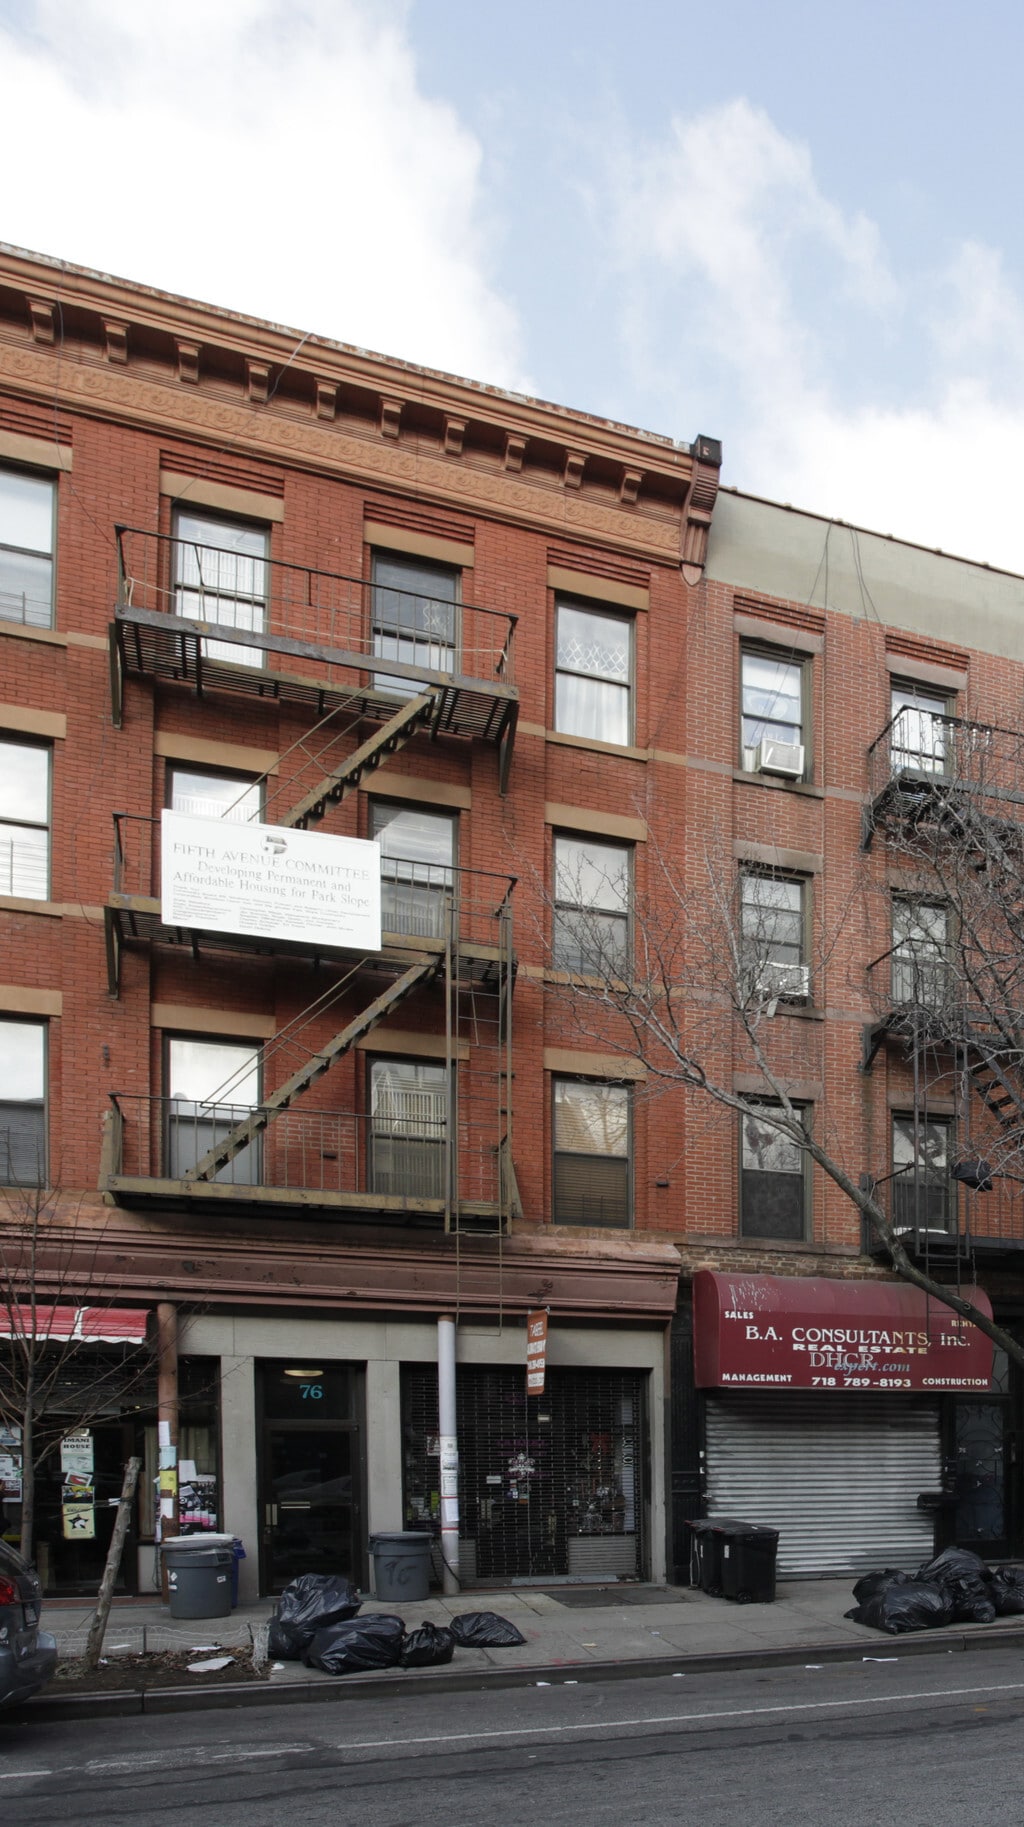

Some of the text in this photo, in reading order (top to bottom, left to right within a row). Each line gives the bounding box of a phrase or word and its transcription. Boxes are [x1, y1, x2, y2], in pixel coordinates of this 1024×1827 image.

[173, 842, 371, 881] FIFTH AVENUE COMMITTEE
[198, 860, 352, 892] Developing Permanent and
[173, 871, 235, 889] Affordable
[240, 879, 287, 897] Housing
[291, 886, 306, 899] for
[312, 889, 336, 903] Park
[341, 892, 370, 908] Slope
[724, 1311, 754, 1320] SALES
[745, 1325, 783, 1341] B.A.
[792, 1327, 933, 1348] CONSULTANTS,
[792, 1343, 928, 1355] REAL ESTATE
[809, 1352, 875, 1368] DHCR
[834, 1359, 911, 1377] expert.com
[722, 1373, 793, 1382] MANAGEMENT
[811, 1376, 837, 1386] 718
[922, 1377, 989, 1386] CONSTRUCTION
[300, 1384, 323, 1399] 76
